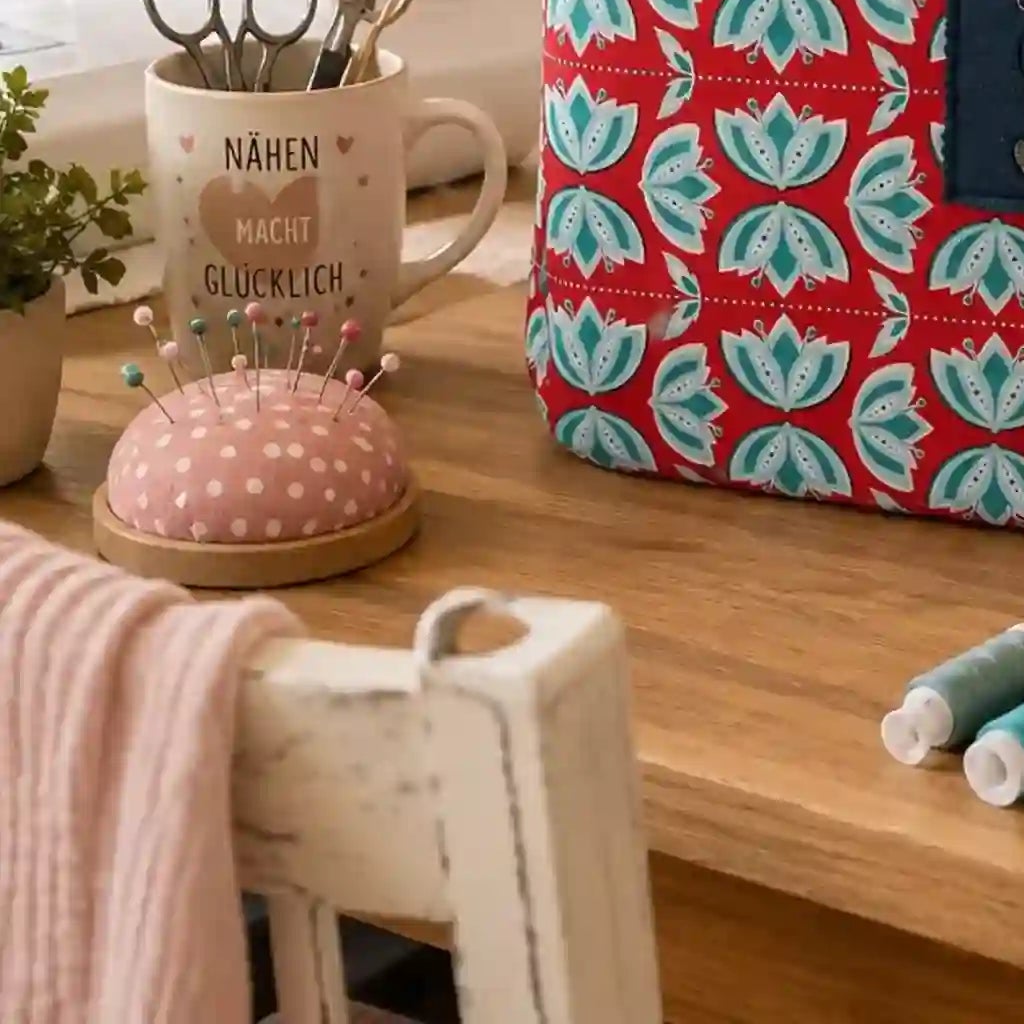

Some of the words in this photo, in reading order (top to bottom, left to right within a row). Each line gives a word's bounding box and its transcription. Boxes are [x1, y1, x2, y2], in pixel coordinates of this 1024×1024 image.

[225, 131, 319, 172] NÄHEN
[236, 216, 312, 245] MACHT
[205, 262, 343, 298] GLÜCKLICH
